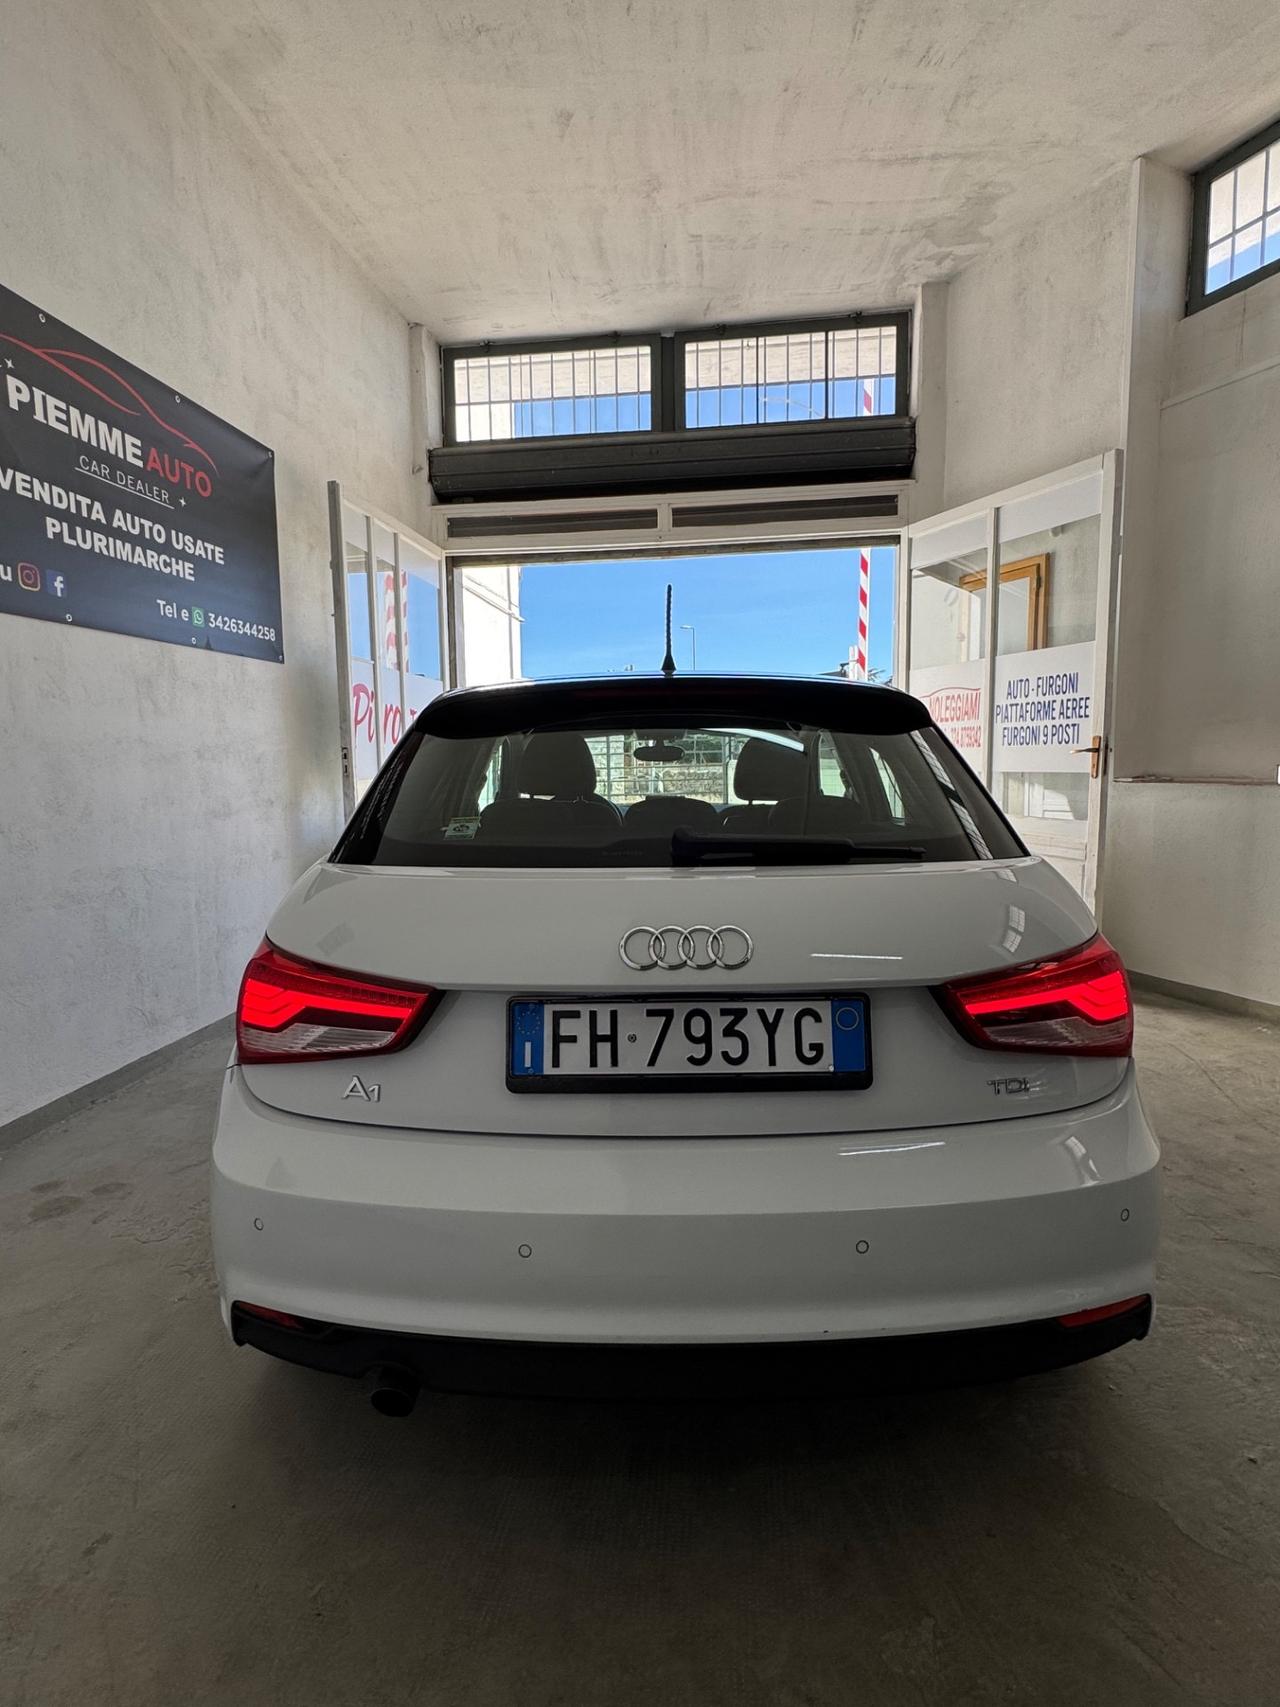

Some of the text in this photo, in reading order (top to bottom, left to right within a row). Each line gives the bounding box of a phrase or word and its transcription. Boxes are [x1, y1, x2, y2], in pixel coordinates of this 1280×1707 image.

[79, 455, 170, 504] CAR DEALER
[0, 464, 225, 566] VENDITA AUTO USATE
[45, 516, 195, 582] PLURIMARCHE
[156, 599, 276, 642] Tel e 3426344258
[1007, 678, 1030, 700] AUTO
[1036, 672, 1079, 697] FURGONI
[995, 696, 1090, 724] PIATTAFORME AEREE
[1002, 723, 1080, 746] FURGONI 9 POSTI
[341, 1075, 381, 1102] A1
[987, 1077, 1030, 1095] TDI
